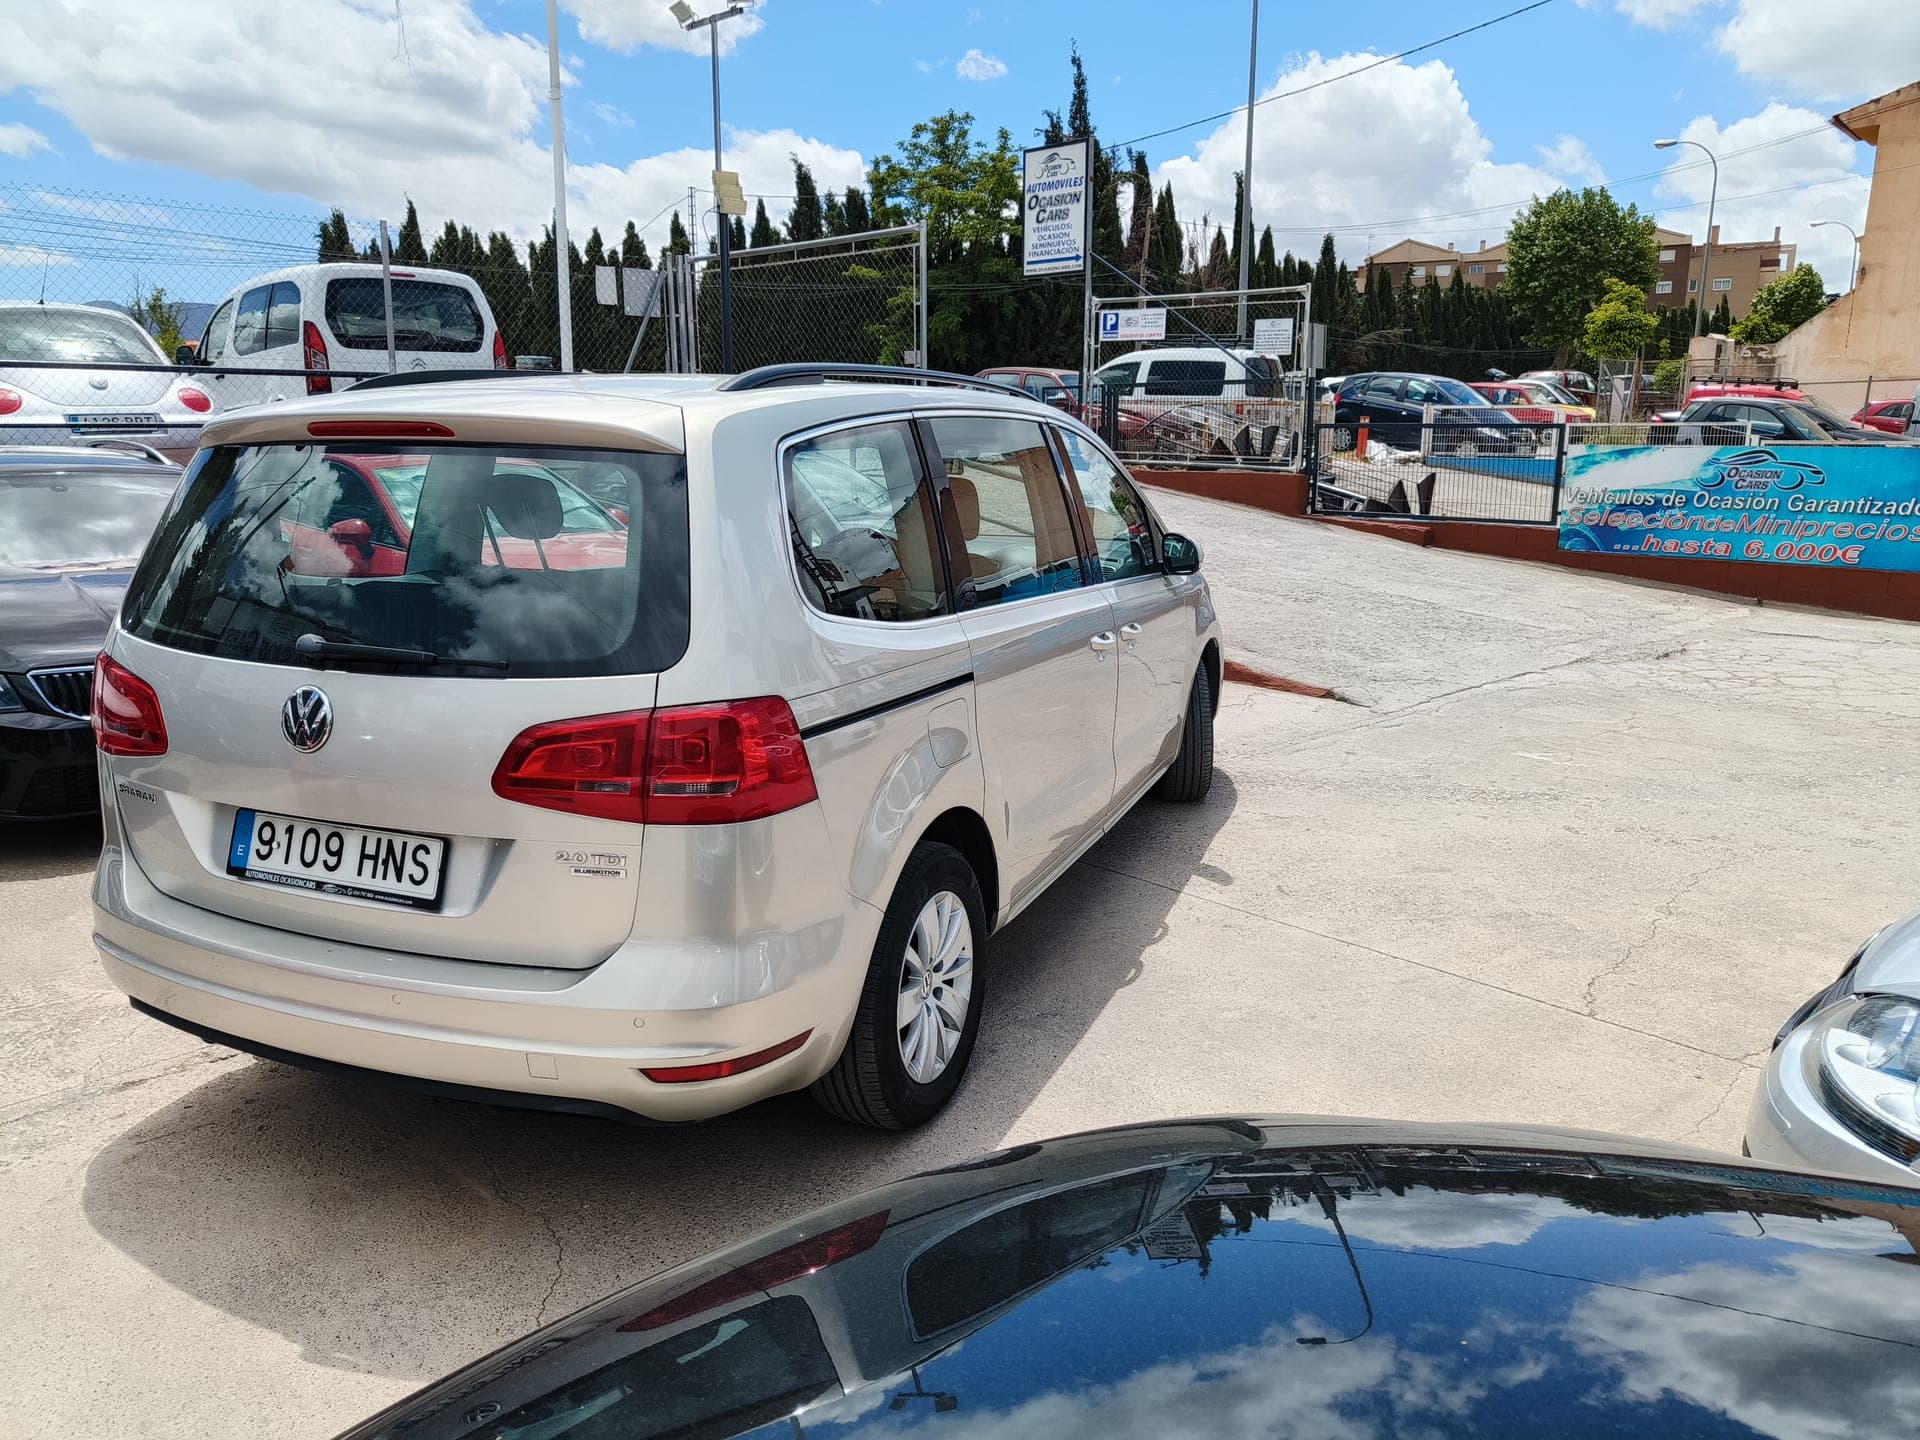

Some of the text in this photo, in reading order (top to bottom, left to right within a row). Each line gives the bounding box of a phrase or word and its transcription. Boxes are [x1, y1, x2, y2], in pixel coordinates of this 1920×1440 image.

[1026, 176, 1084, 194] AUTOMOVILES
[1028, 191, 1083, 210] OCASION
[1036, 208, 1070, 224] CARS
[1031, 239, 1076, 250] SEMINUEVOS
[1727, 466, 1784, 479] OCASION
[1735, 479, 1769, 490] CARS
[1565, 486, 1655, 506] Vehículos
[1662, 490, 1686, 507] de
[1693, 491, 1779, 511] Ocasión
[1744, 539, 1865, 564] 6.000€
[236, 844, 246, 856] E
[255, 820, 431, 887] 9109 HNS
[590, 853, 627, 867] TDI
[245, 870, 280, 883] AUTOMOVILES
[573, 868, 621, 876] BLUEMOTION
